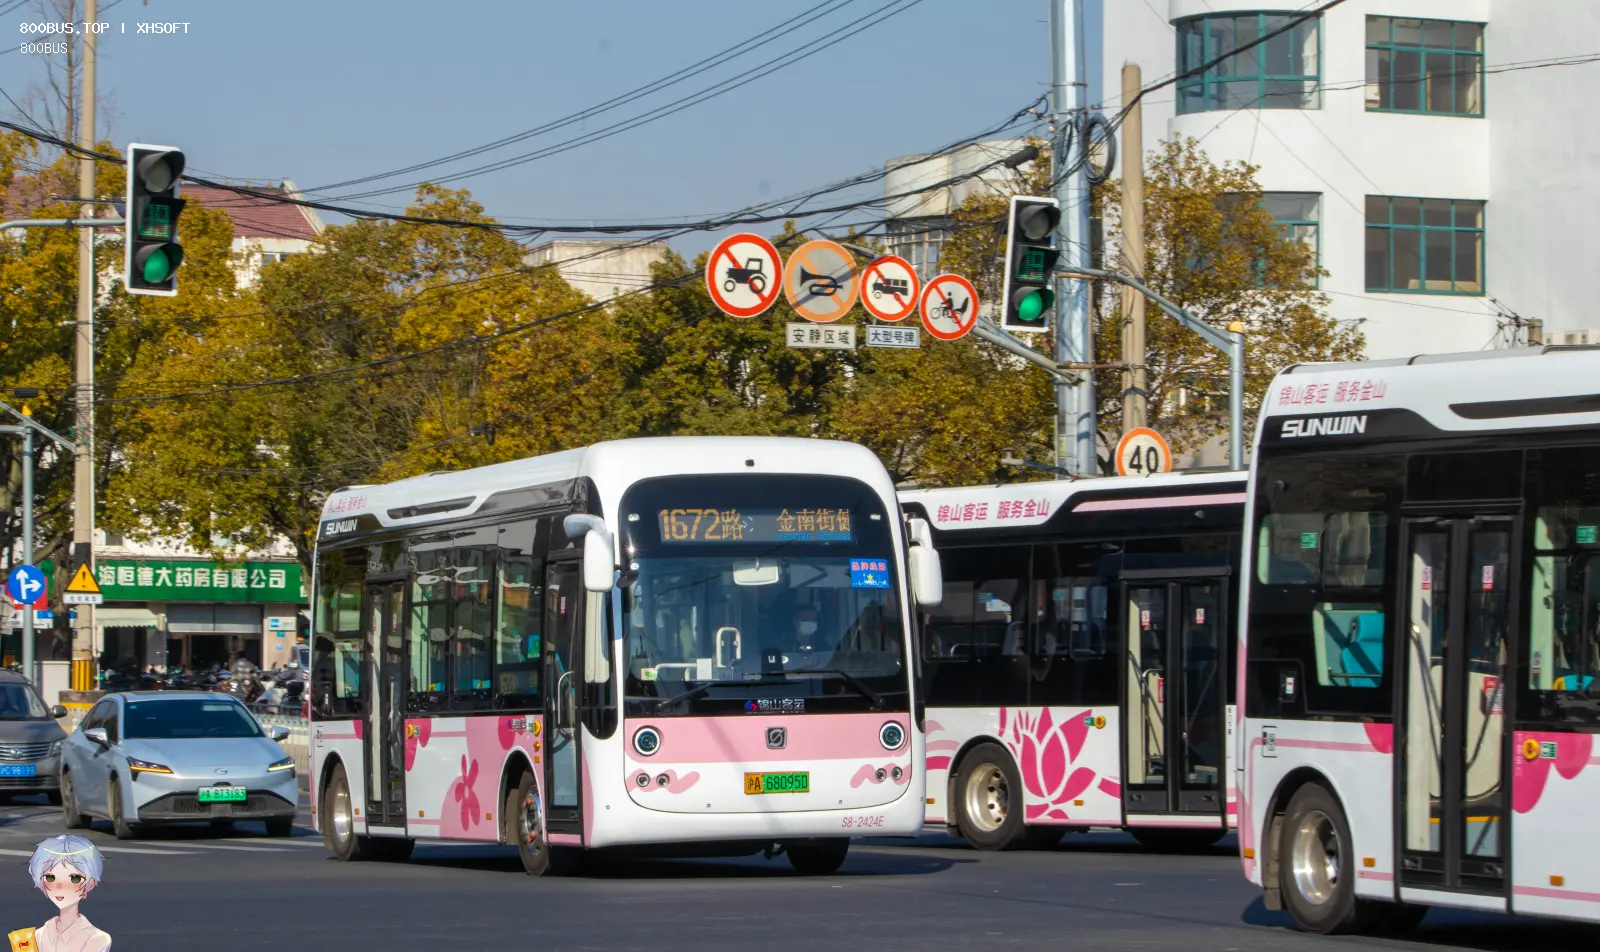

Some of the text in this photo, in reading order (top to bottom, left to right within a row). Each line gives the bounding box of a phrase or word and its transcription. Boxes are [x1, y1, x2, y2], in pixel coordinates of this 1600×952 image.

[793, 328, 850, 345] 安静区域
[871, 329, 915, 344] 大型号牌
[1333, 379, 1387, 403] 服务金山
[1280, 415, 1367, 438] SUNWIN
[1129, 445, 1159, 473] 40
[937, 498, 1050, 522] 锦山客运 服务金山
[326, 519, 357, 535] SUNWIN
[658, 508, 744, 540] 1672路
[841, 815, 885, 828] S8-2424E
